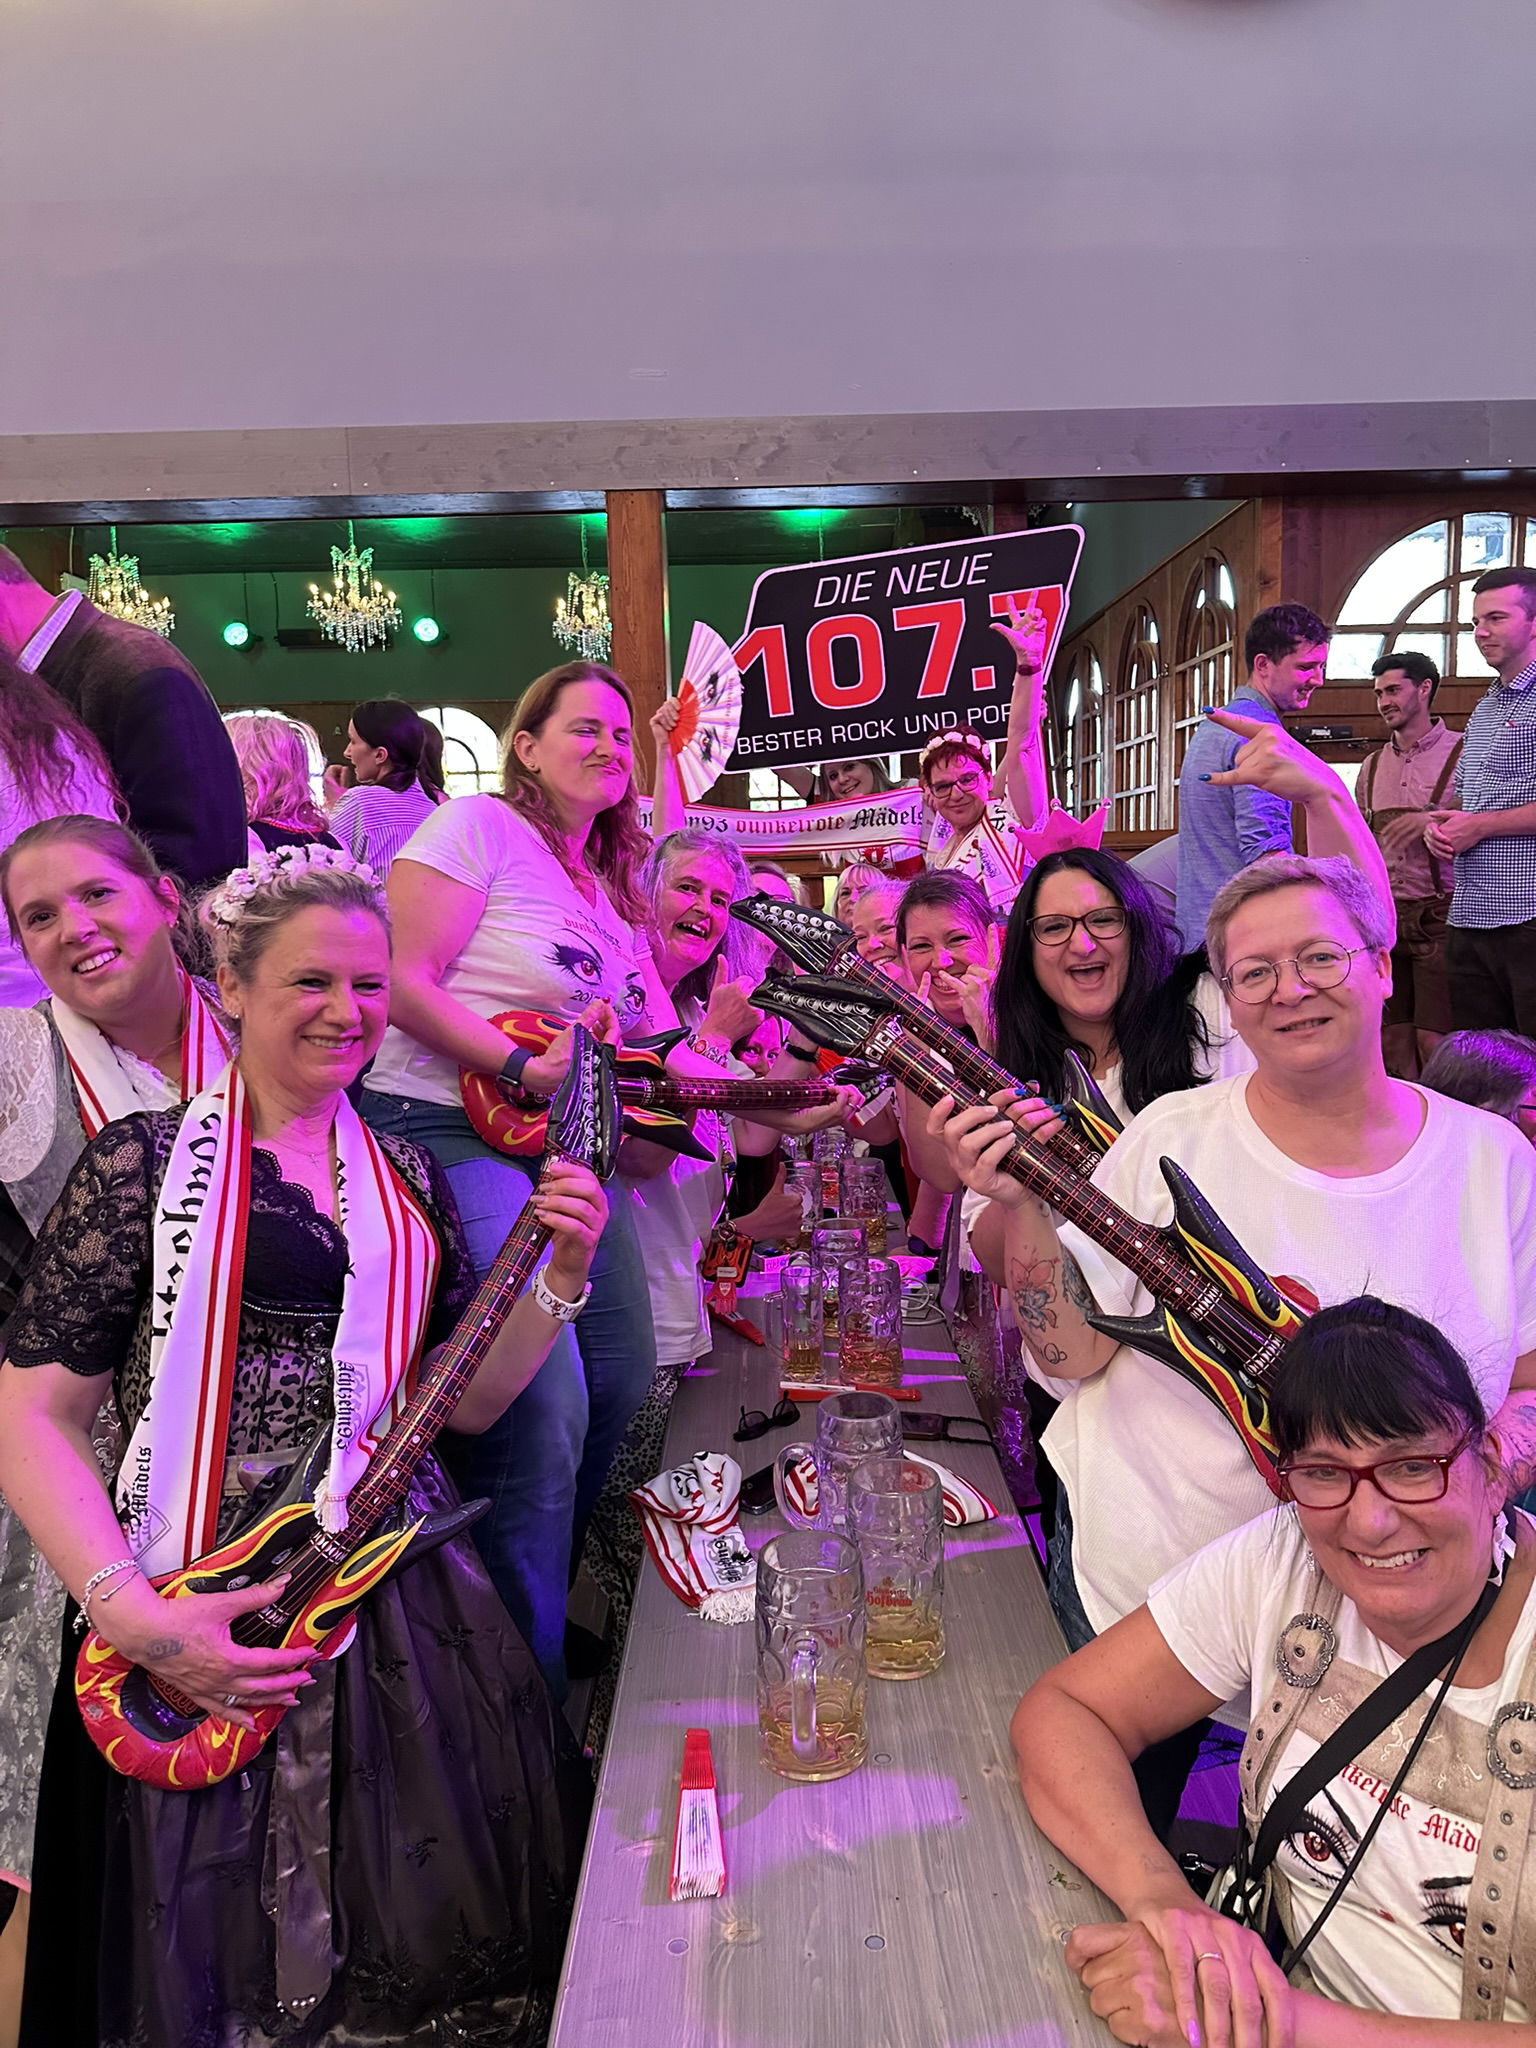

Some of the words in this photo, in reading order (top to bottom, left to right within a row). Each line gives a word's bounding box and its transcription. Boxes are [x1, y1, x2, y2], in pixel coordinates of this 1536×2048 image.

[814, 570, 876, 607] DIE
[886, 552, 993, 598] NEUE
[736, 728, 823, 755] BESTER
[831, 718, 896, 743] ROCK
[904, 710, 957, 735] UND
[735, 815, 845, 834] dunkelrote
[849, 805, 923, 831] Mädels
[335, 1361, 356, 1455] Achtzehn93
[131, 1446, 152, 1517] Mädels
